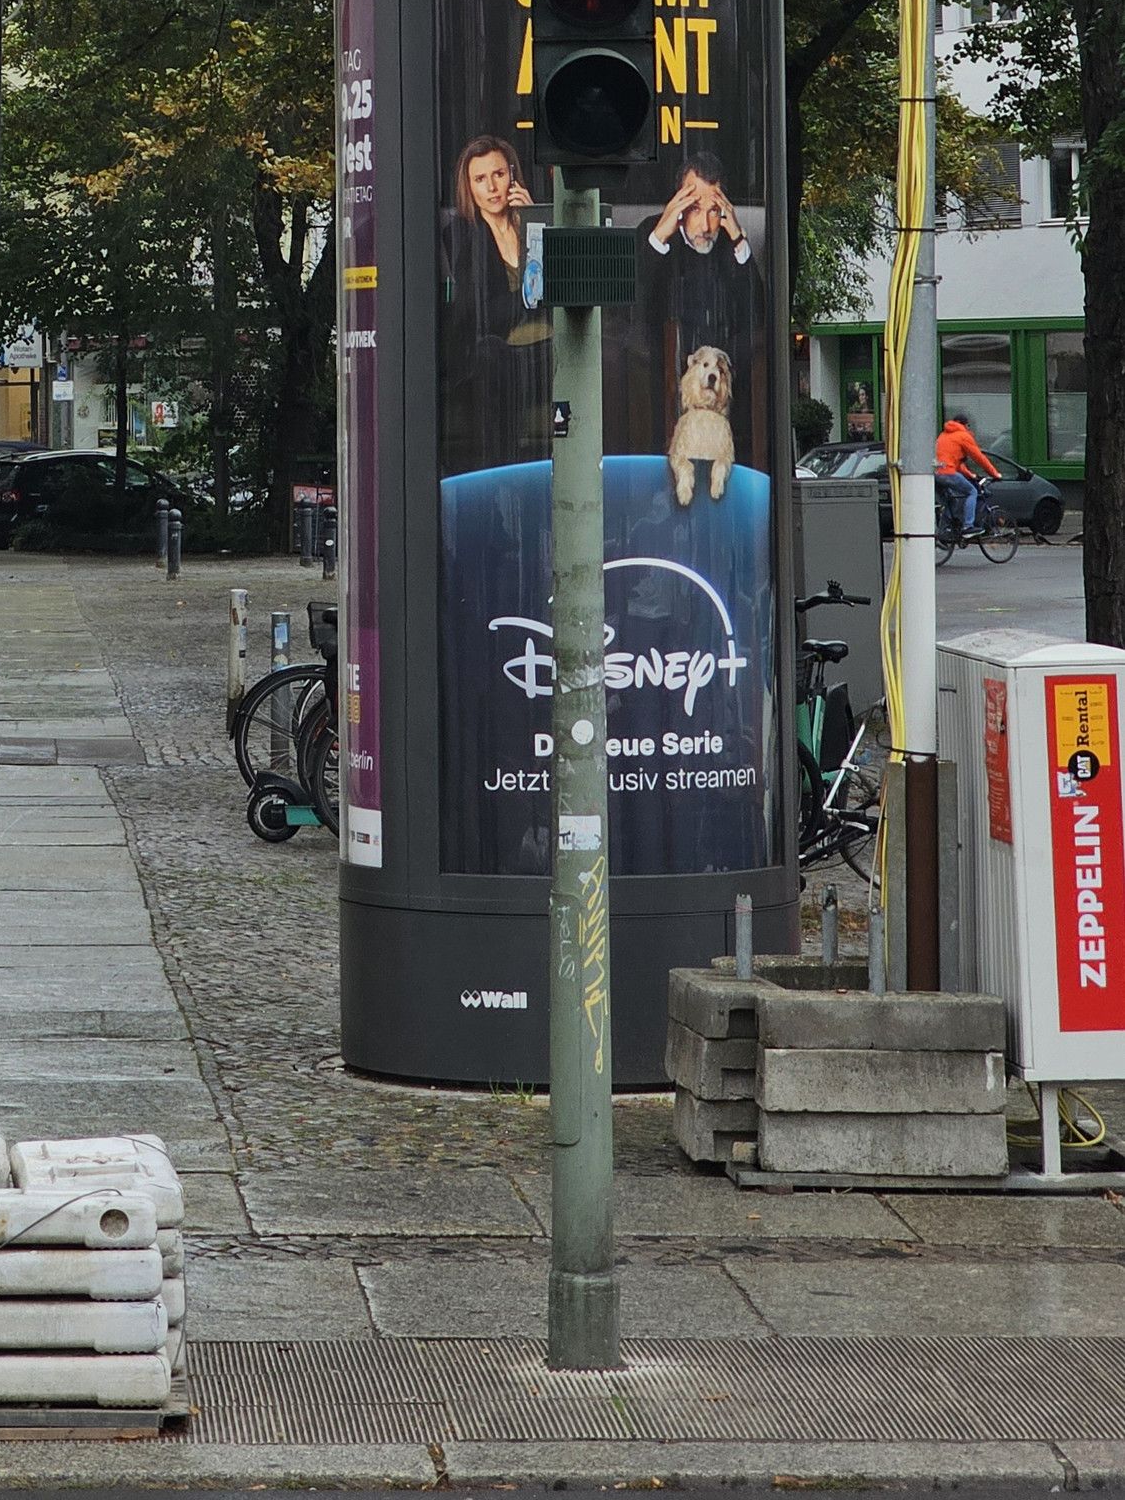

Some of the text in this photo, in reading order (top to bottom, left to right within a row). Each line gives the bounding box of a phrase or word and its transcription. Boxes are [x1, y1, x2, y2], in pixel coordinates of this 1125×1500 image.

[1074, 690, 1091, 747] Rental
[662, 730, 724, 756] Serie
[483, 768, 551, 792] Jetzt
[665, 766, 757, 790] streamen
[1076, 755, 1092, 779] CAT
[1073, 805, 1107, 989] ZEPPELIN
[480, 990, 528, 1009] Wall
